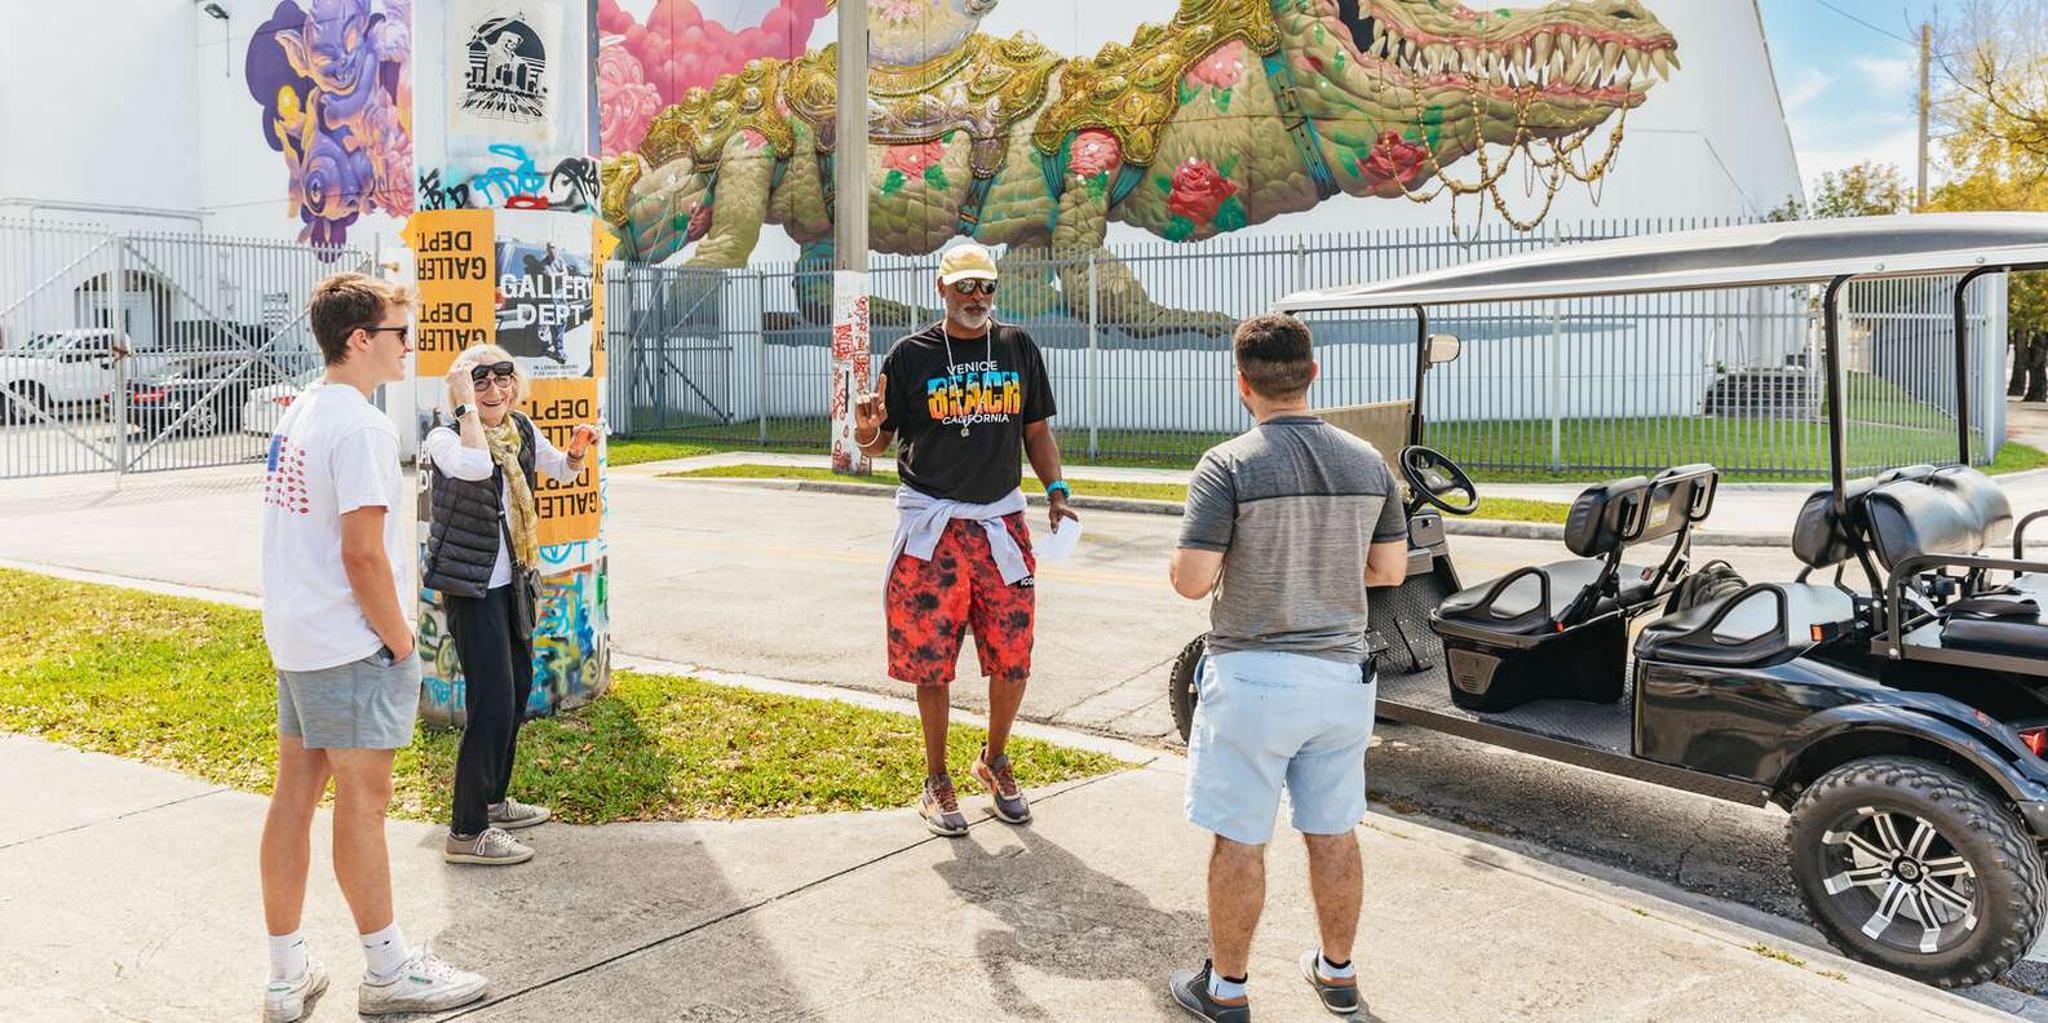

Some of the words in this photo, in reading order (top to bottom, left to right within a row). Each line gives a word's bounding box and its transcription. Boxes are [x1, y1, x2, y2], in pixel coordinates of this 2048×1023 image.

[946, 360, 998, 375] VENICE
[925, 370, 1022, 421] BEACH
[941, 413, 1010, 425] CALIFORNIA
[534, 491, 597, 519] GALLE
